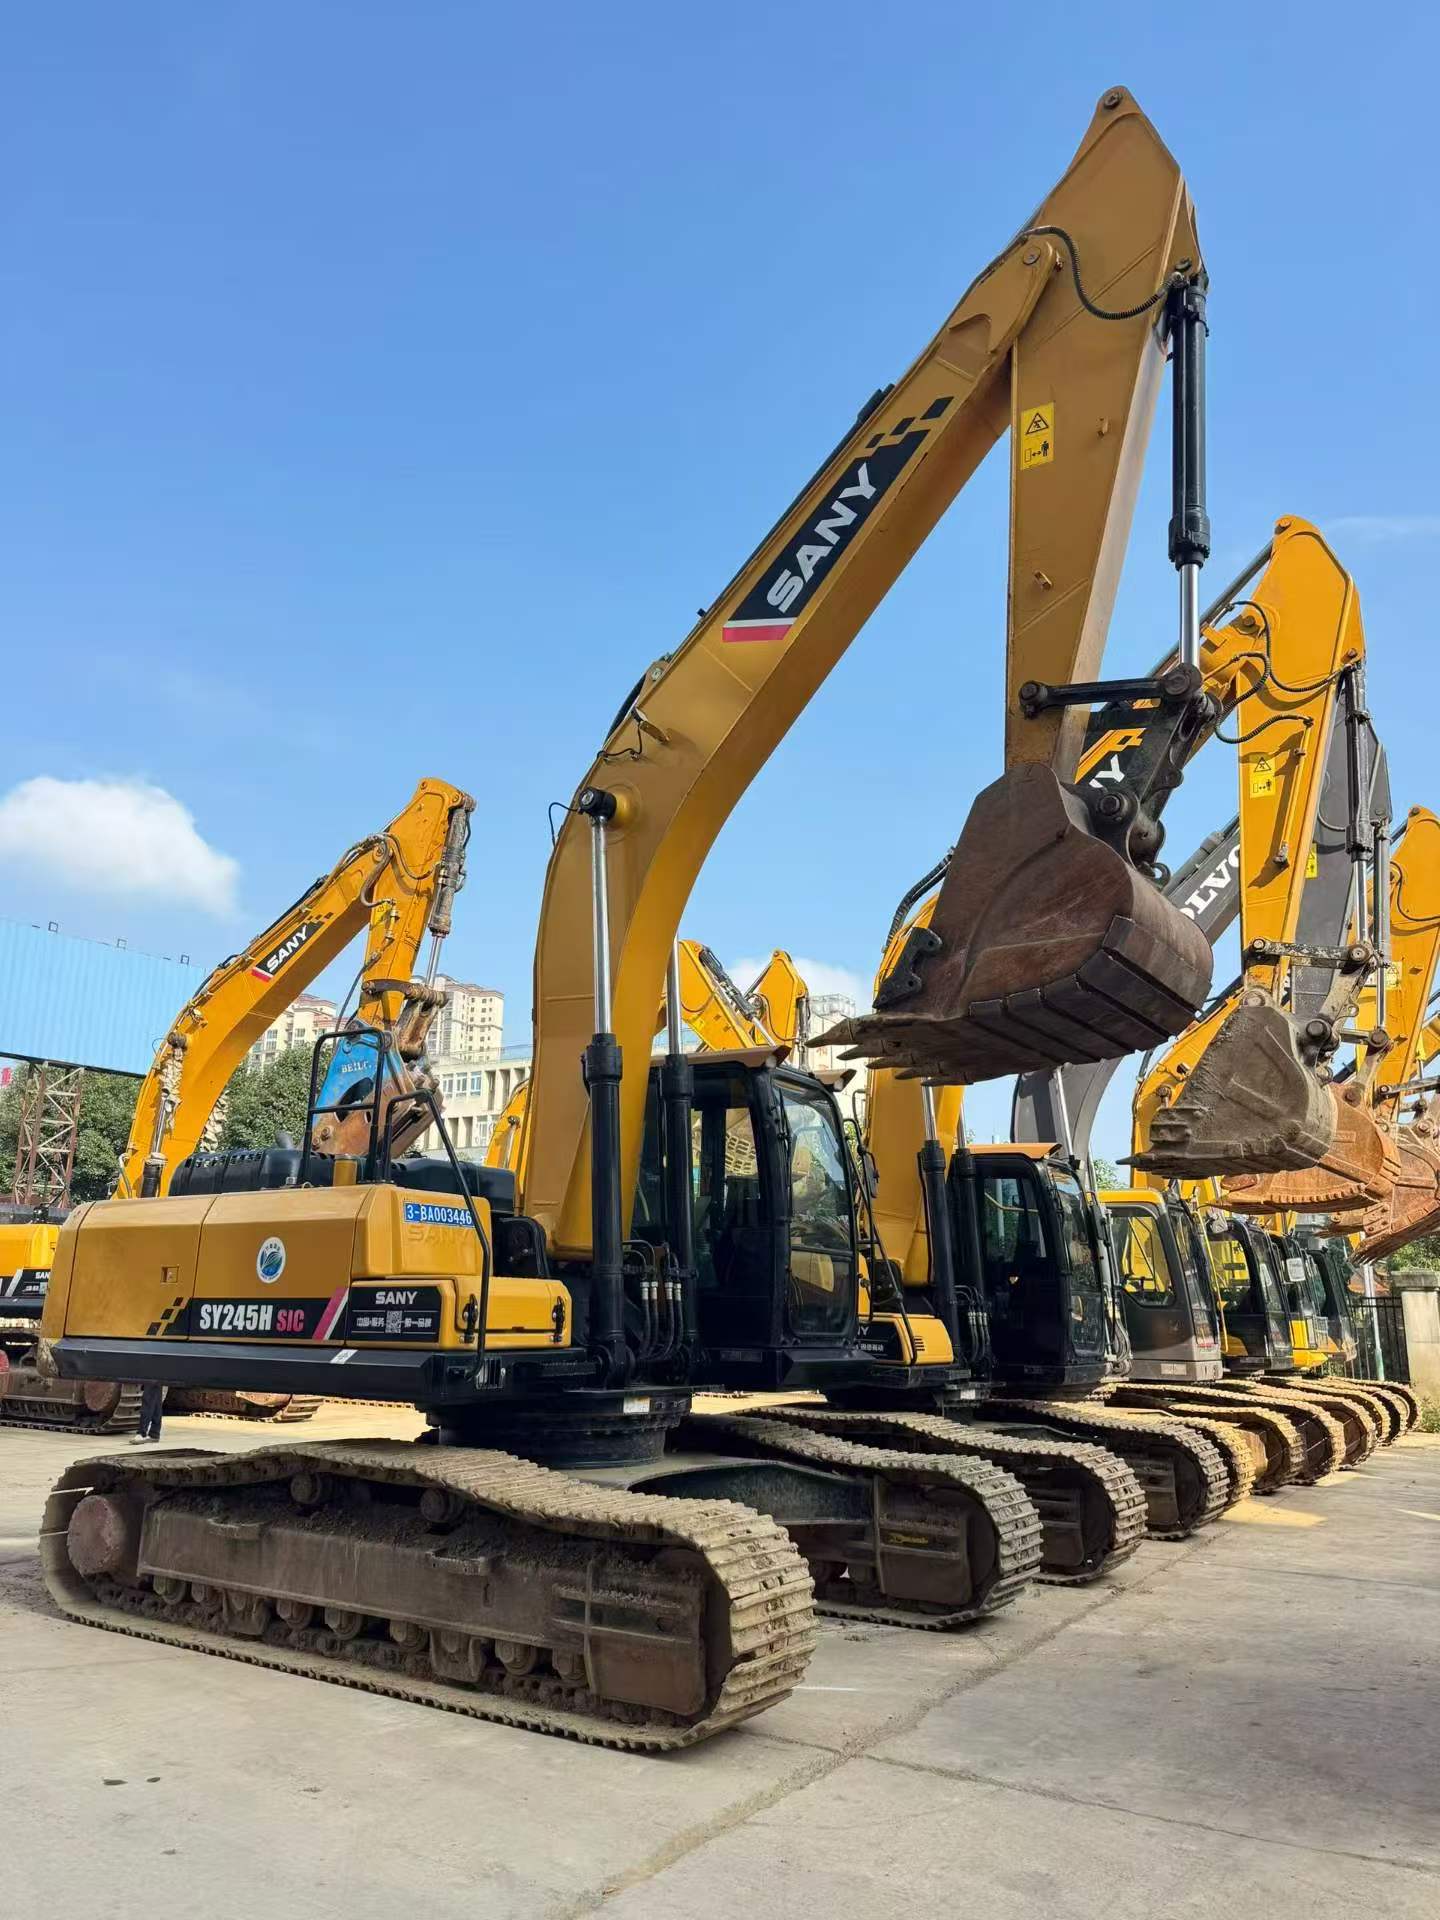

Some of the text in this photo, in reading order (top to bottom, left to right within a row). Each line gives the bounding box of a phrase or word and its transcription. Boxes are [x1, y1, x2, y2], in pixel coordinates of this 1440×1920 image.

[766, 462, 877, 613] SANY
[266, 924, 308, 973] SANY
[406, 1204, 472, 1225] 3-BA003446
[375, 1291, 418, 1305] SANY
[199, 1303, 305, 1332] SY245H SIC
